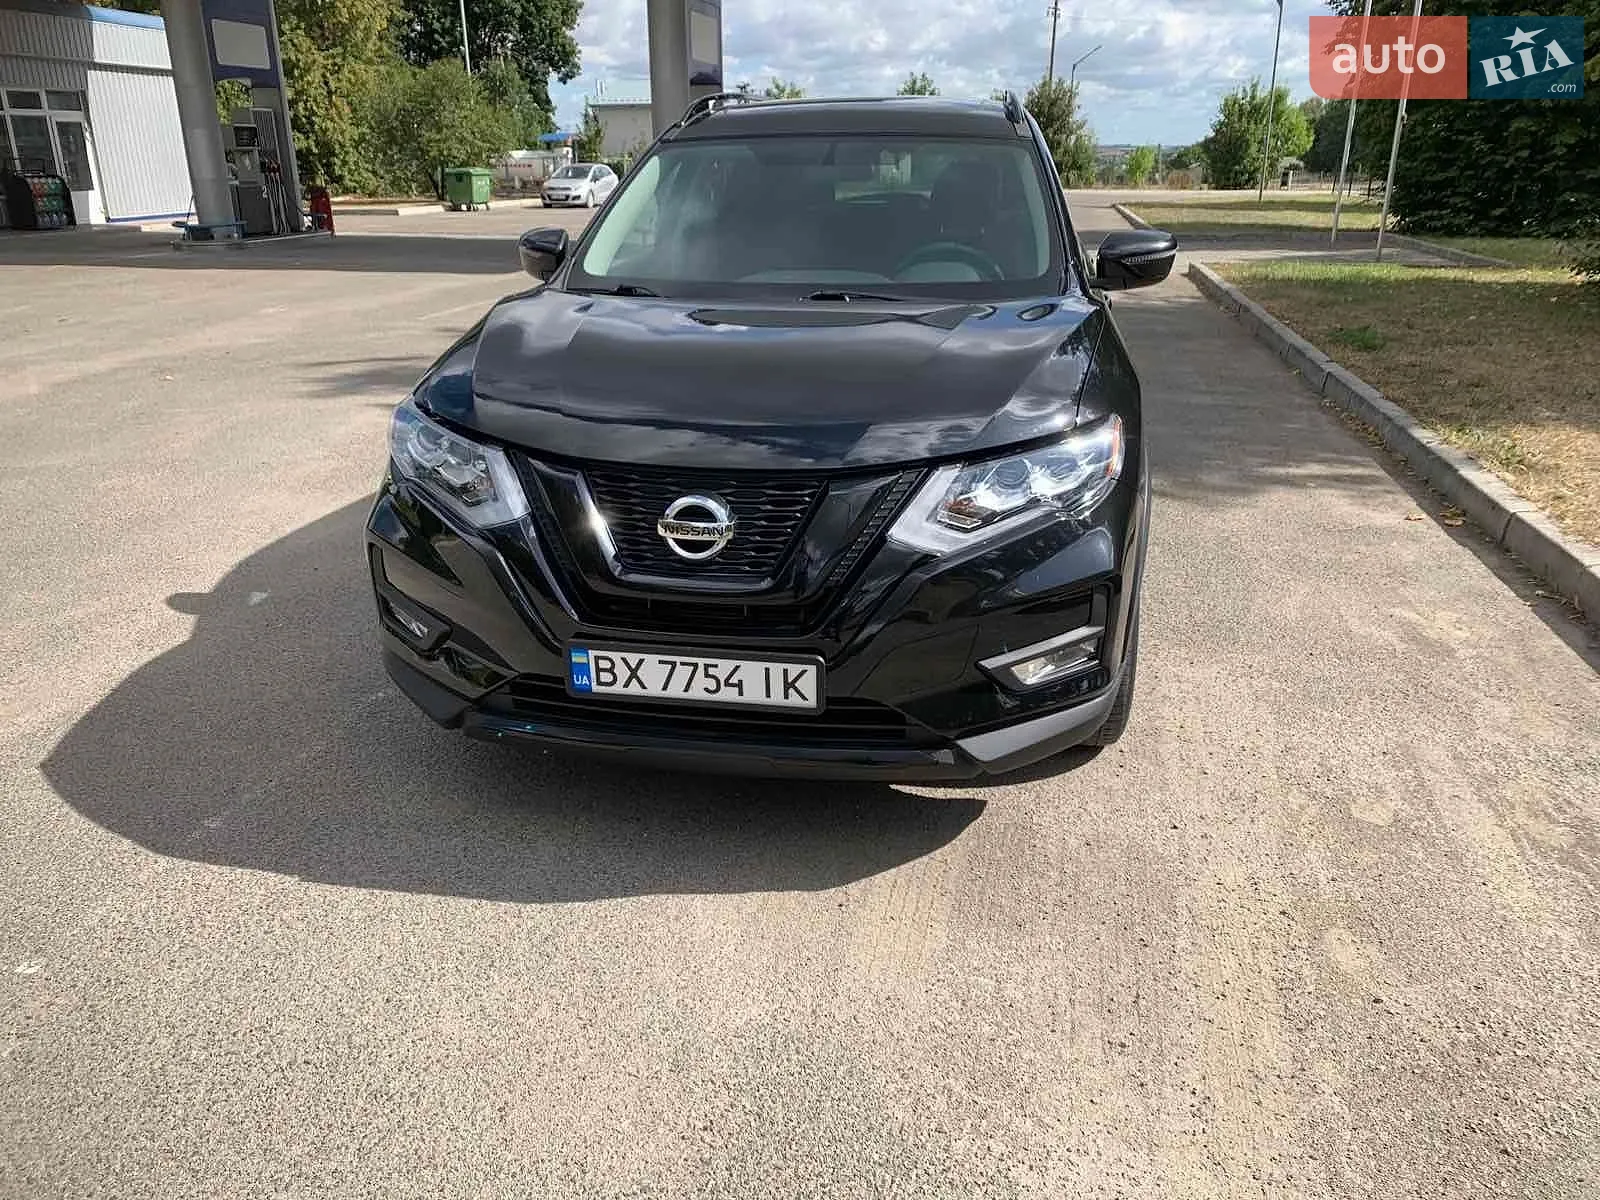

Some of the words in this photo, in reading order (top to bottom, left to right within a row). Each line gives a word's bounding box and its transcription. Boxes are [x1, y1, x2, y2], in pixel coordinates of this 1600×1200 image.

[663, 524, 726, 537] NISSAN
[574, 674, 590, 687] UA
[594, 655, 648, 690] BX
[658, 659, 744, 697] 7754
[765, 666, 809, 702] IK
